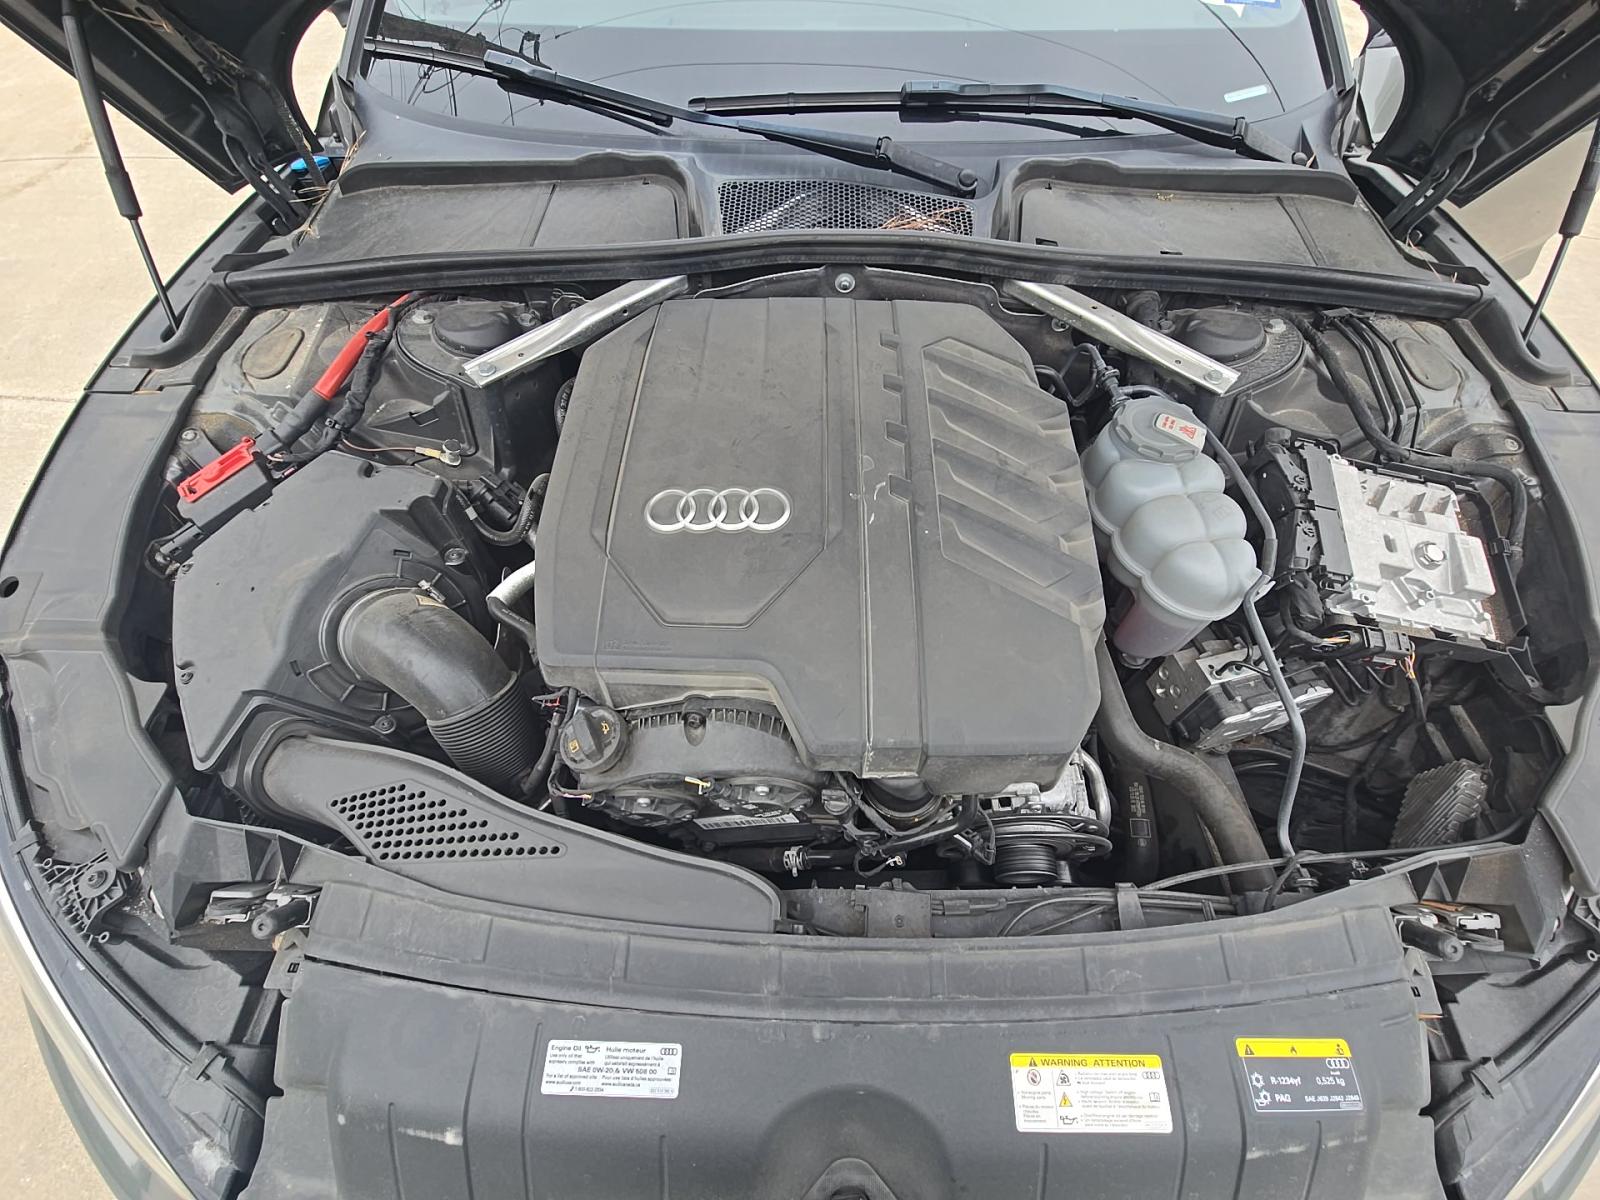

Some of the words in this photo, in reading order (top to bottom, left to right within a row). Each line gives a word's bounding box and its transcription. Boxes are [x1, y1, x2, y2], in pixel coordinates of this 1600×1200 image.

[1041, 1058, 1088, 1067] WARNING
[1093, 1059, 1146, 1068] ATTENTION
[1270, 1076, 1302, 1086] R-1234yf
[1316, 1077, 1336, 1086] 0,525
[1336, 1077, 1346, 1087] kg
[1275, 1094, 1291, 1103] PAG
